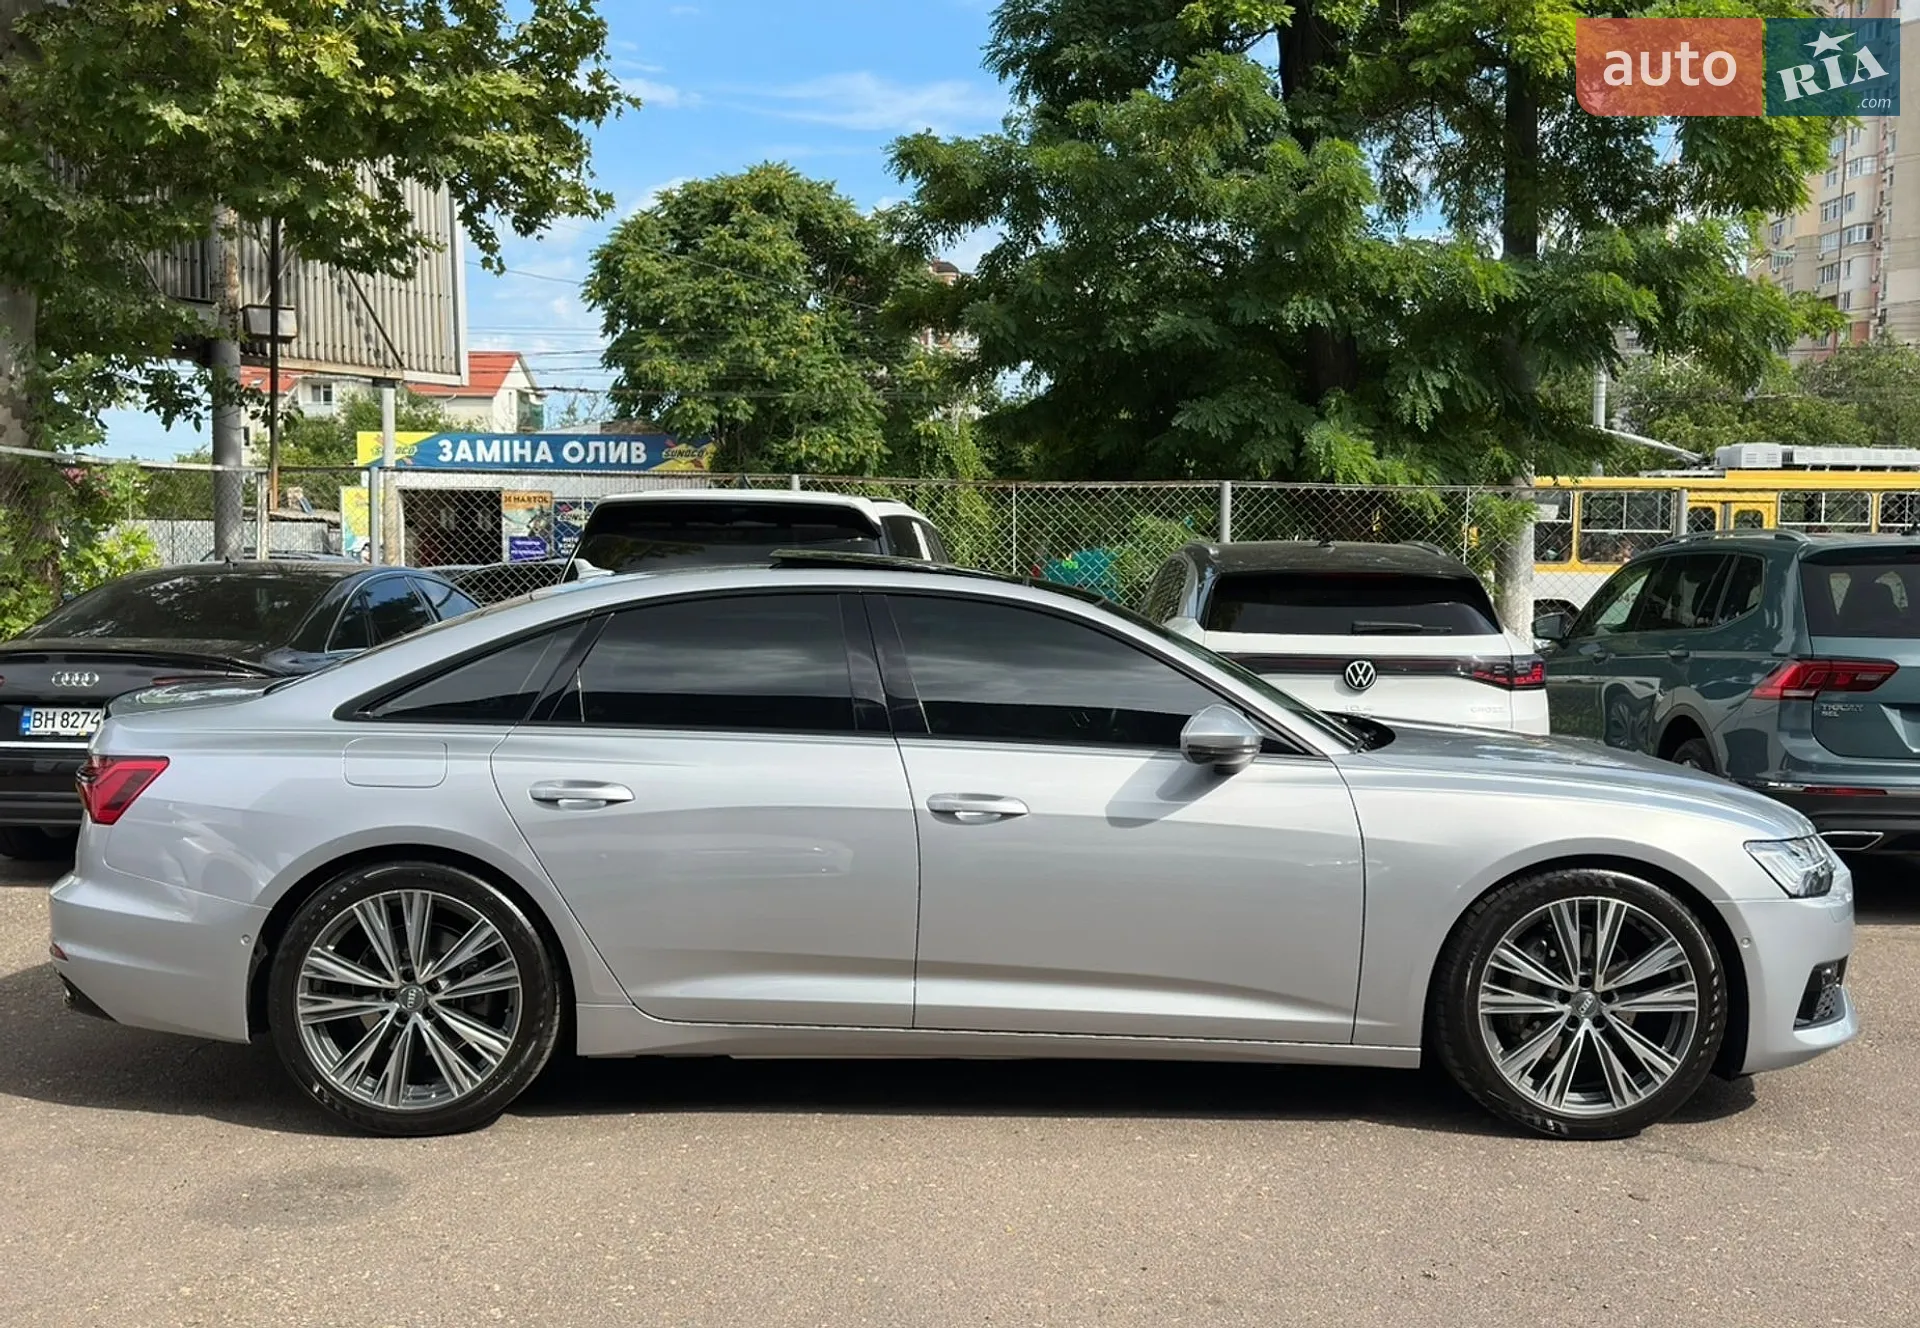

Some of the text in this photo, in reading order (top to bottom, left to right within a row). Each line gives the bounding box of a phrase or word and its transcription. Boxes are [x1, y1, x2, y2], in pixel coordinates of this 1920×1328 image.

[437, 439, 648, 464] ЗАМІНА ОЛИВ
[664, 448, 704, 458] SUNOCO
[32, 711, 100, 731] BH 8274
